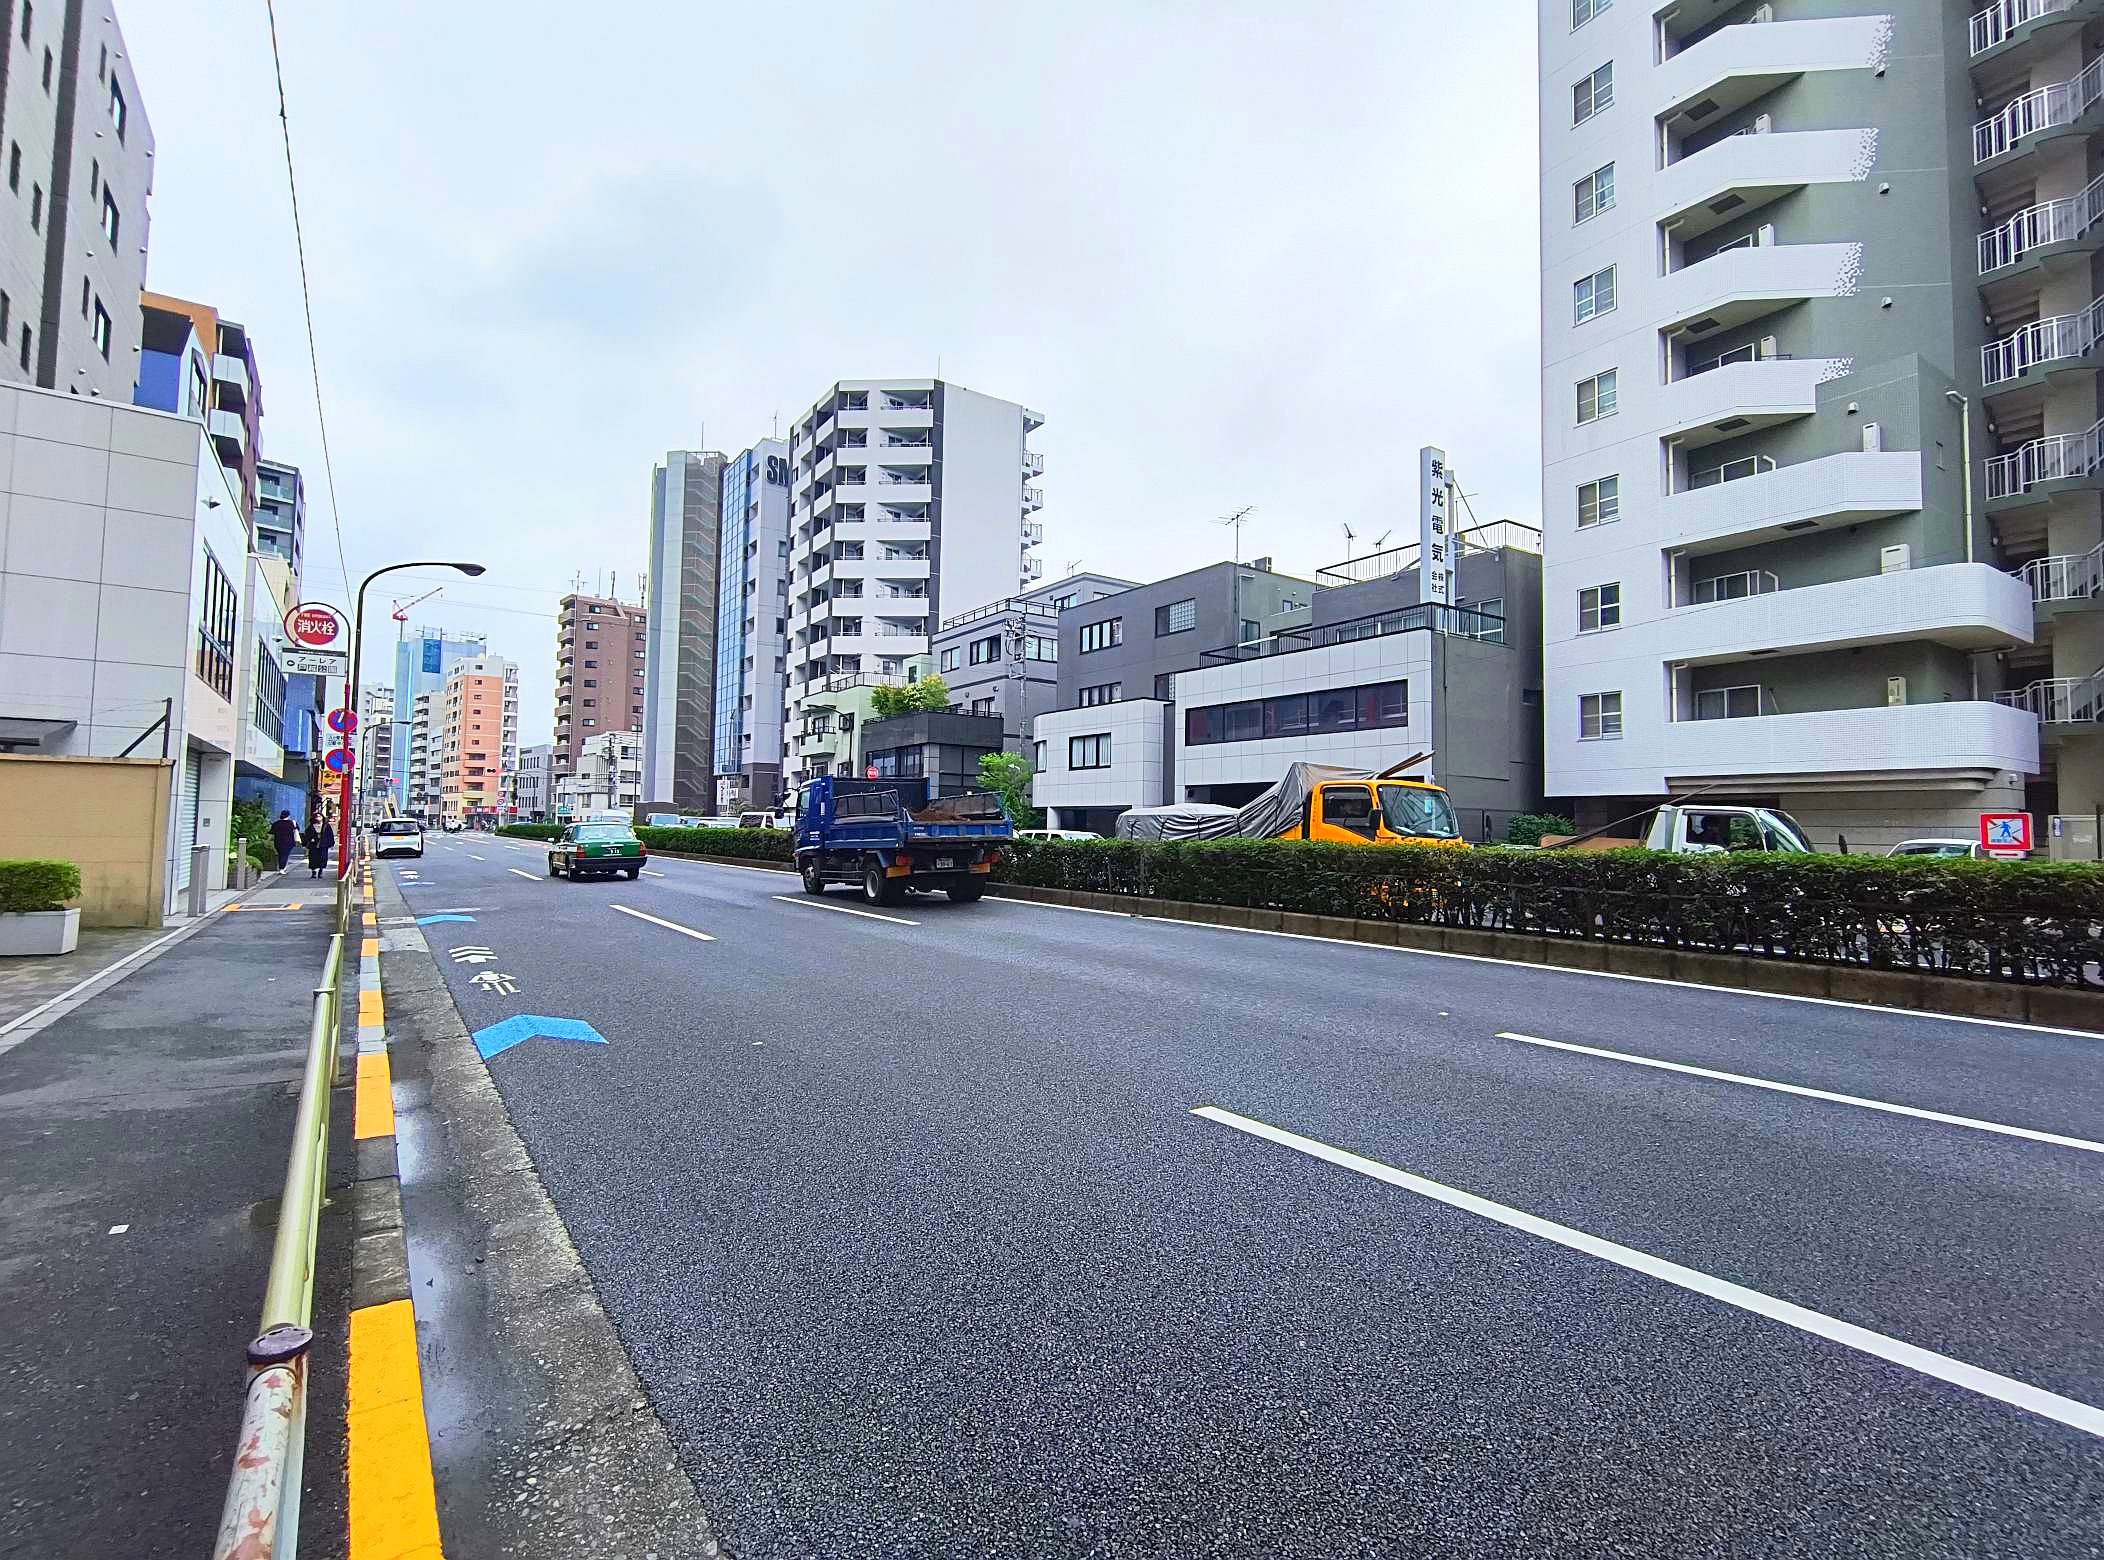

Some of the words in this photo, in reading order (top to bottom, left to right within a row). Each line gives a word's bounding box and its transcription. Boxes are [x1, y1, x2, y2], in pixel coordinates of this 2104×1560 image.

[1431, 459, 1444, 563] 紫光電気
[297, 619, 336, 636] 消火栓
